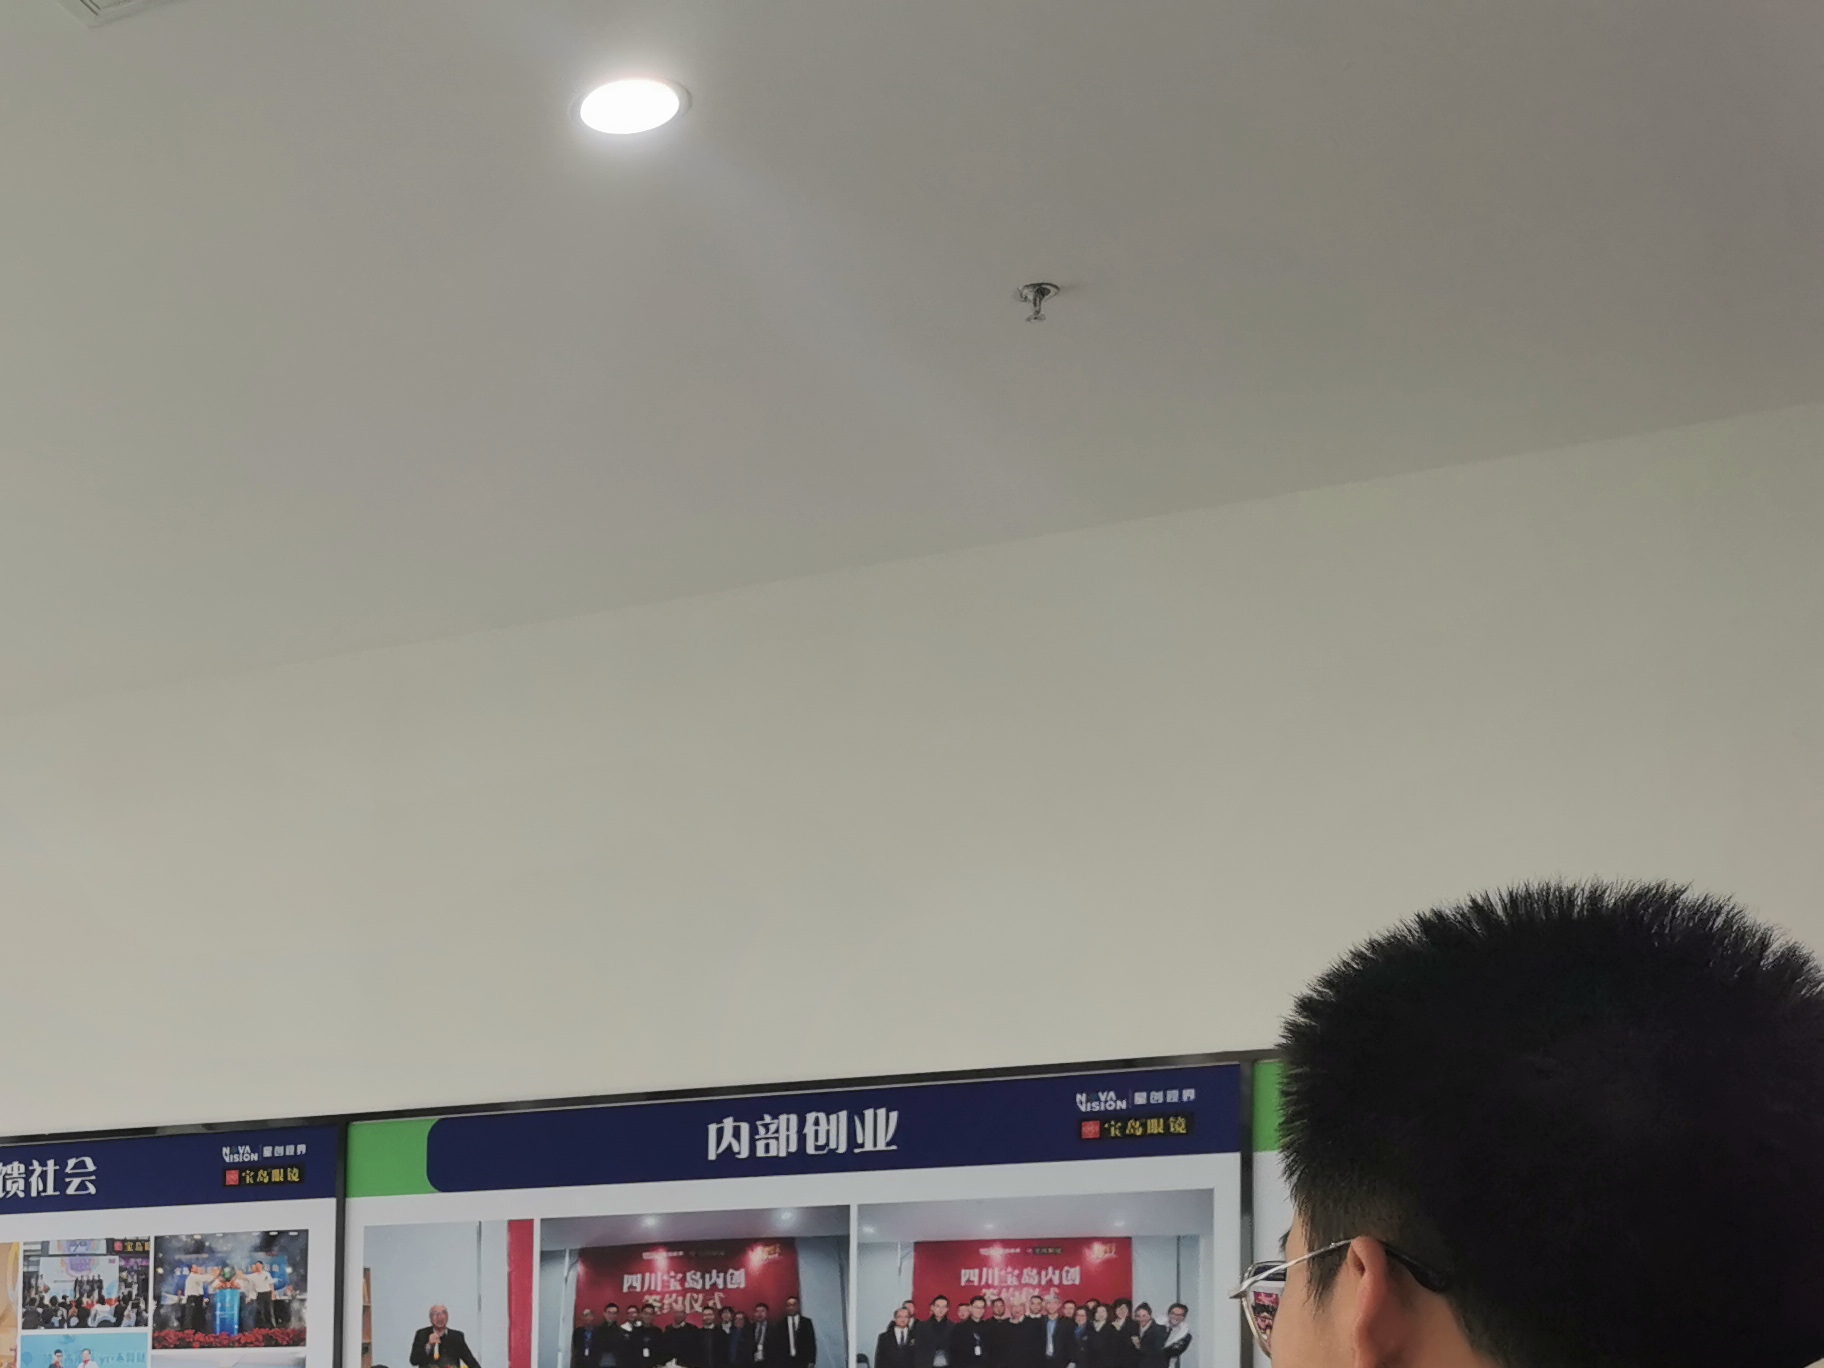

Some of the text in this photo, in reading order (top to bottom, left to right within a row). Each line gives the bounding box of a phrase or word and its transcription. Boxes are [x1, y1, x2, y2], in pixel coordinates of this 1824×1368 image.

[1077, 1100, 1127, 1112] VISION
[706, 1107, 899, 1160] 内部创业
[622, 1268, 746, 1292] 四川宝岛内创
[961, 1265, 1081, 1287] 四川宝岛内创
